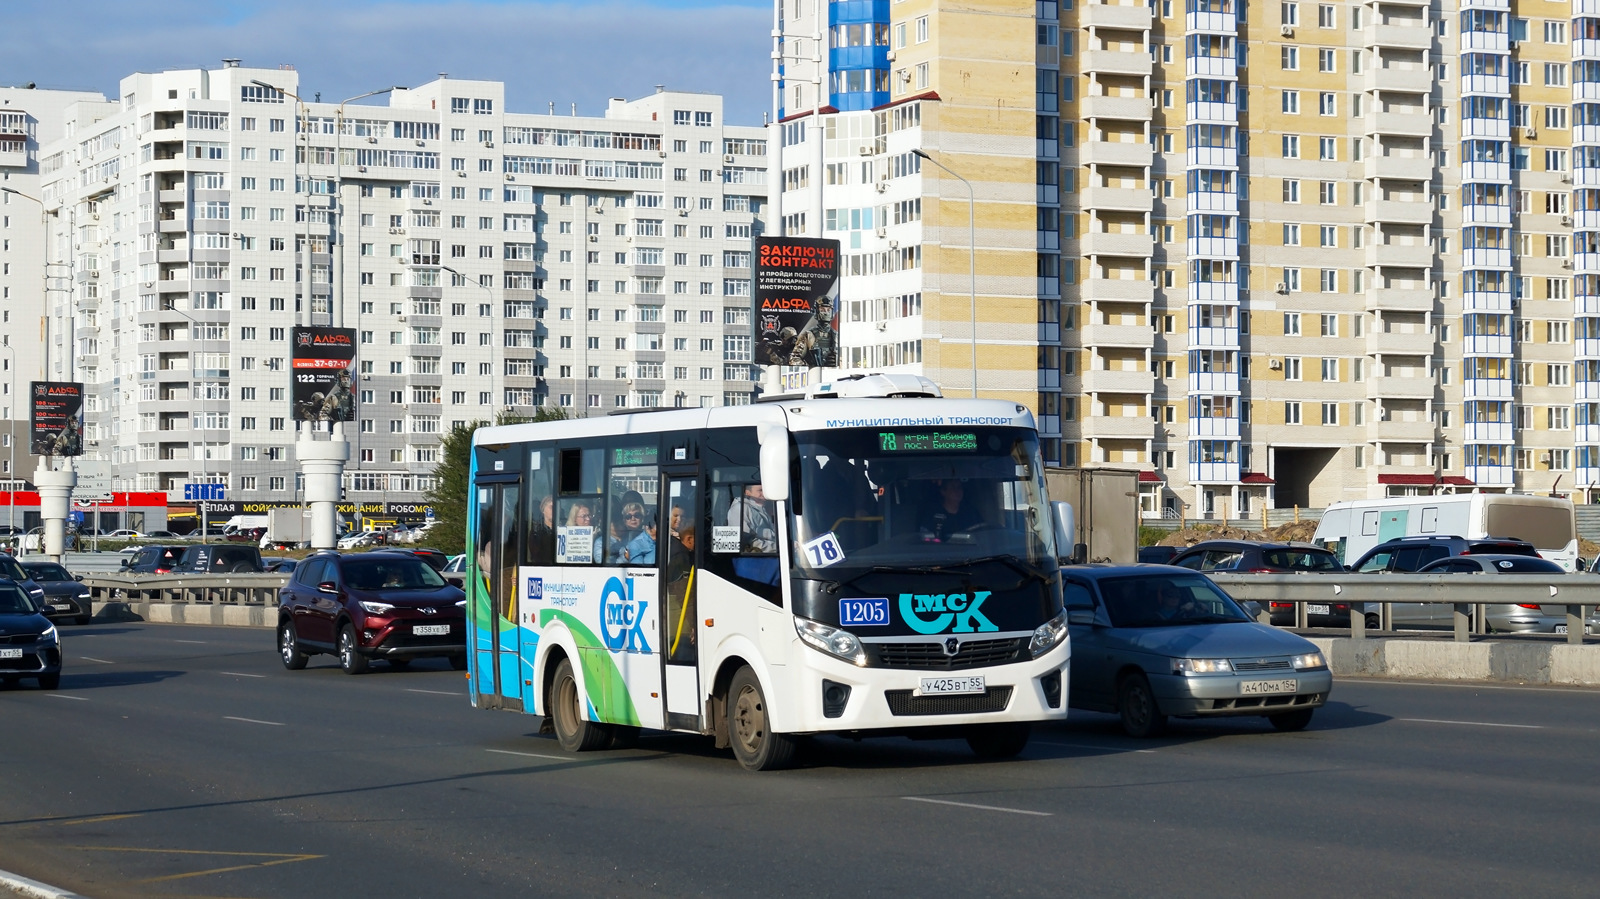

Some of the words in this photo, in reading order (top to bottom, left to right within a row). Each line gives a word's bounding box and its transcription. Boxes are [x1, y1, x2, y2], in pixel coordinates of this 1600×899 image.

[760, 244, 834, 258] ЗАКЛЮЧИ
[760, 256, 834, 268] КОНТРАКТ
[762, 298, 810, 310] АЛЬФА
[314, 334, 351, 344] АЛЬФА
[297, 374, 315, 382] 122
[826, 415, 944, 427] МУНИЦИПАЛЬНЫЙ
[948, 416, 1012, 425] ТРАНСПОРТ
[880, 433, 896, 450] 78
[199, 503, 235, 512] ТЁПЛАЯ
[557, 535, 565, 556] 78
[809, 540, 837, 566] 78
[544, 582, 585, 592] МУНИЦИПАЛЬНЫЙ
[551, 597, 577, 606] ТРАНСПОРТ
[844, 602, 884, 622] 1205
[926, 680, 967, 691] У425ВТ
[970, 678, 980, 686] 55
[1245, 682, 1279, 692] А410МА
